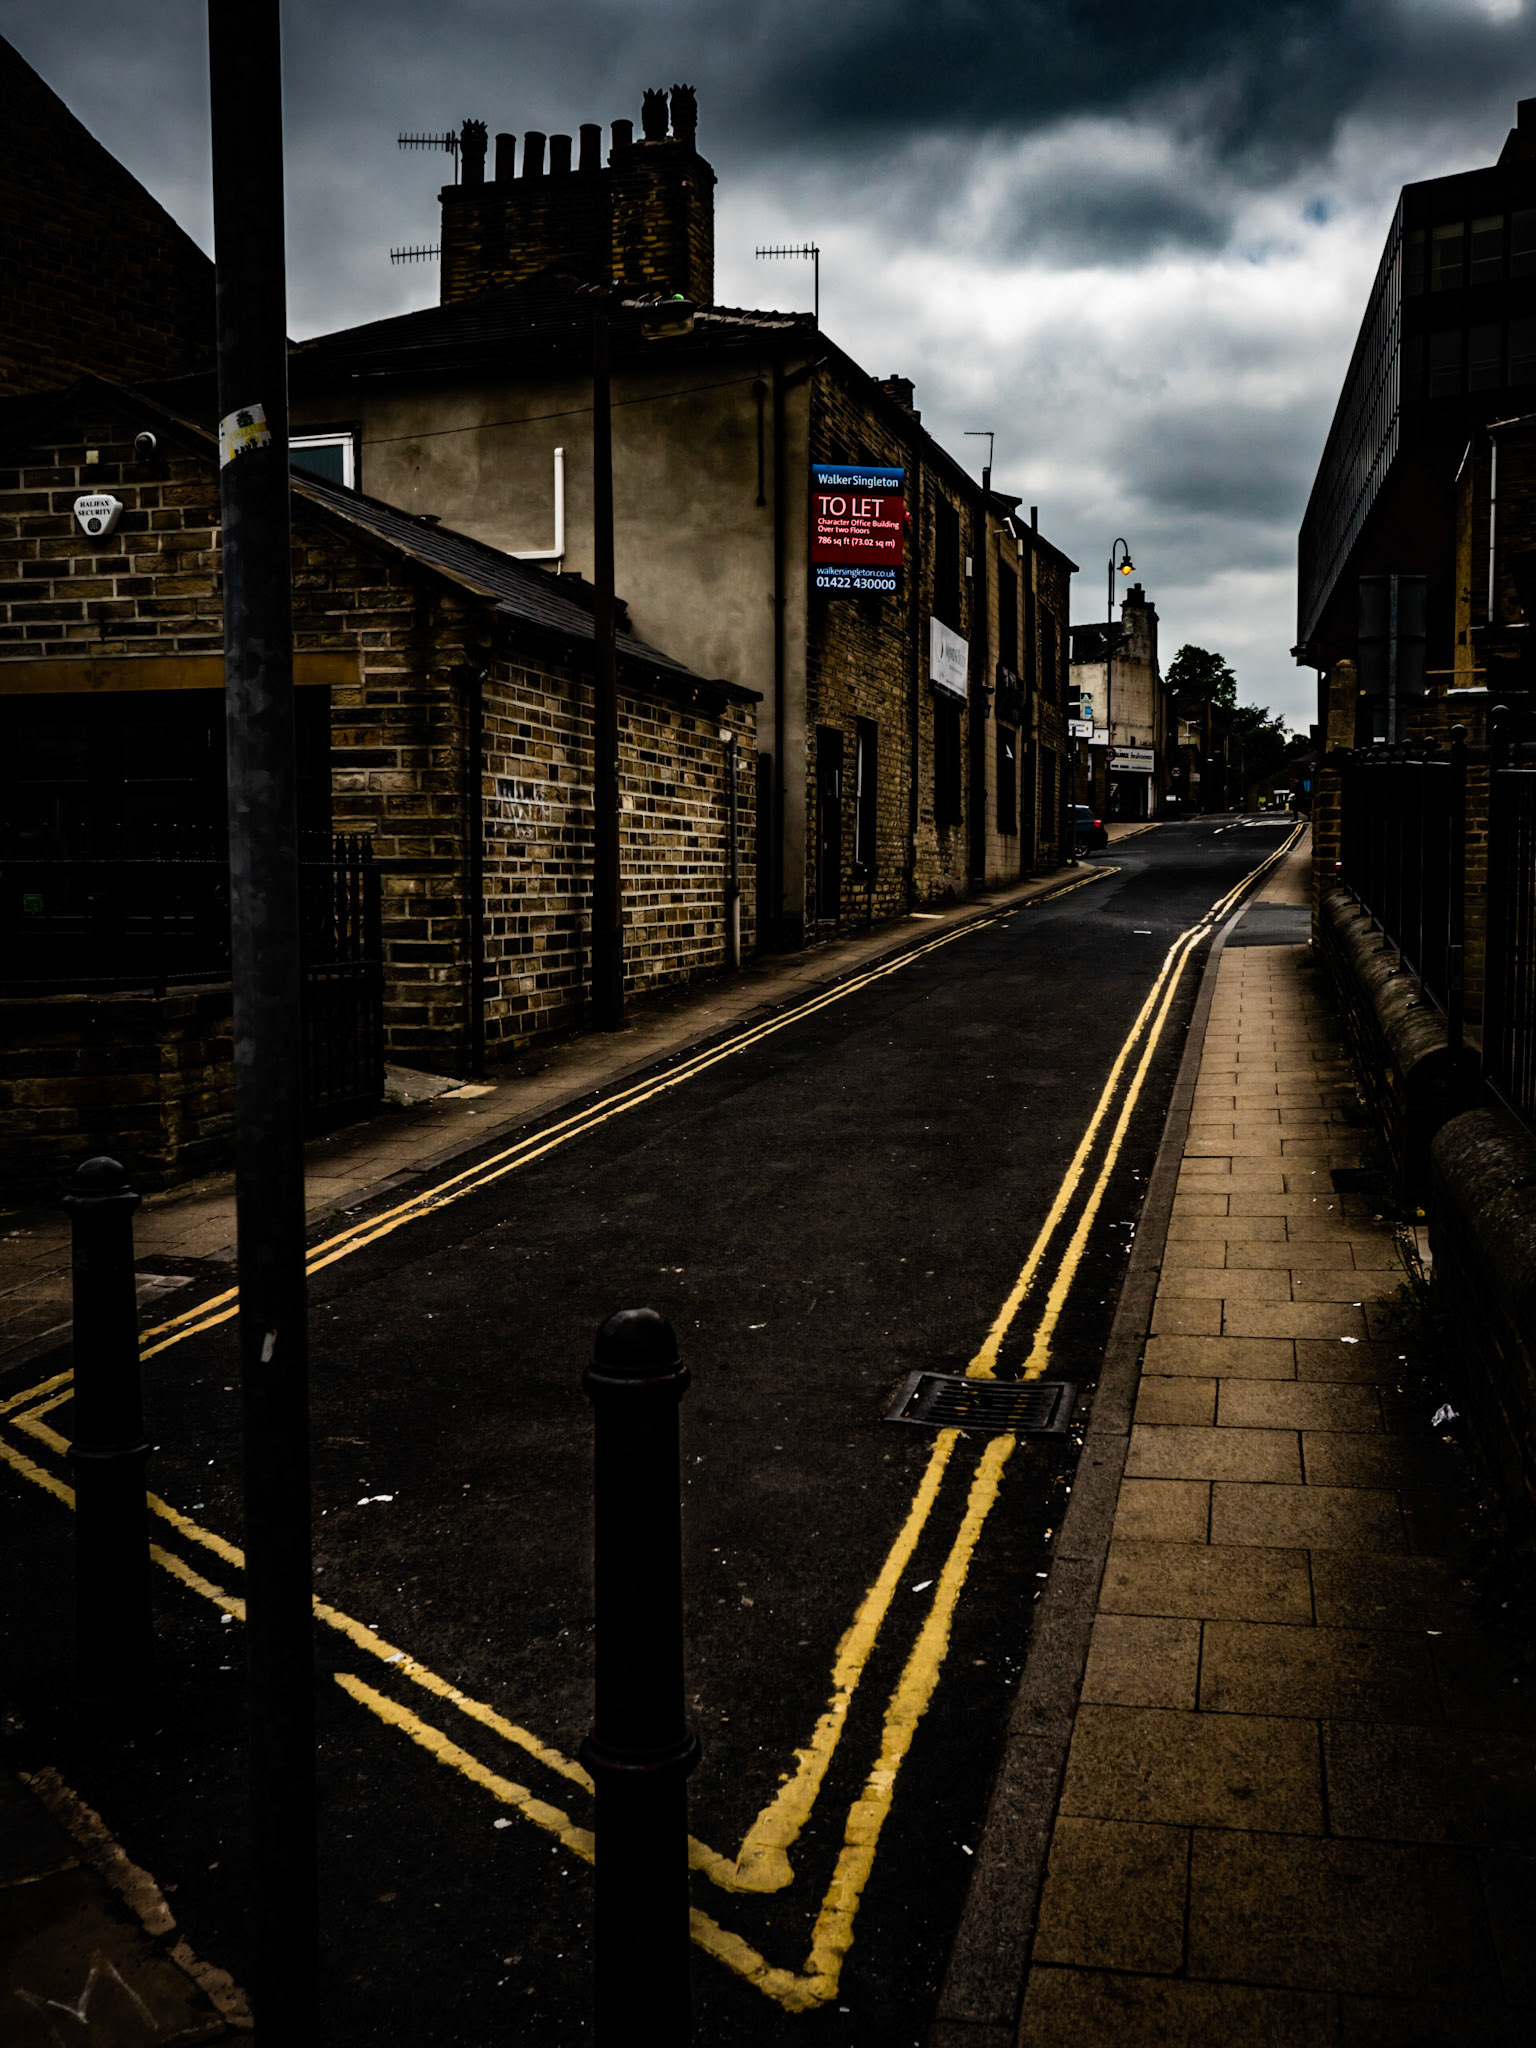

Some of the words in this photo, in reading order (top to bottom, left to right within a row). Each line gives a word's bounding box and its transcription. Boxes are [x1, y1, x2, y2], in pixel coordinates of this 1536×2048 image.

[818, 496, 847, 516] TO
[852, 497, 885, 518] LET
[817, 525, 834, 533] Over
[835, 526, 849, 534] two
[850, 526, 871, 535] Floors
[818, 518, 850, 526] Character
[850, 519, 871, 527] Office
[872, 520, 900, 531] Building
[818, 536, 832, 545] 786
[833, 538, 842, 547] sq
[843, 537, 850, 545] ft
[851, 537, 874, 547] (73.02
[875, 540, 884, 548] sq
[885, 539, 896, 549] m)
[817, 567, 896, 578] walkersingleton.co.uk
[816, 576, 851, 589] 01422
[853, 577, 896, 591] 430000
